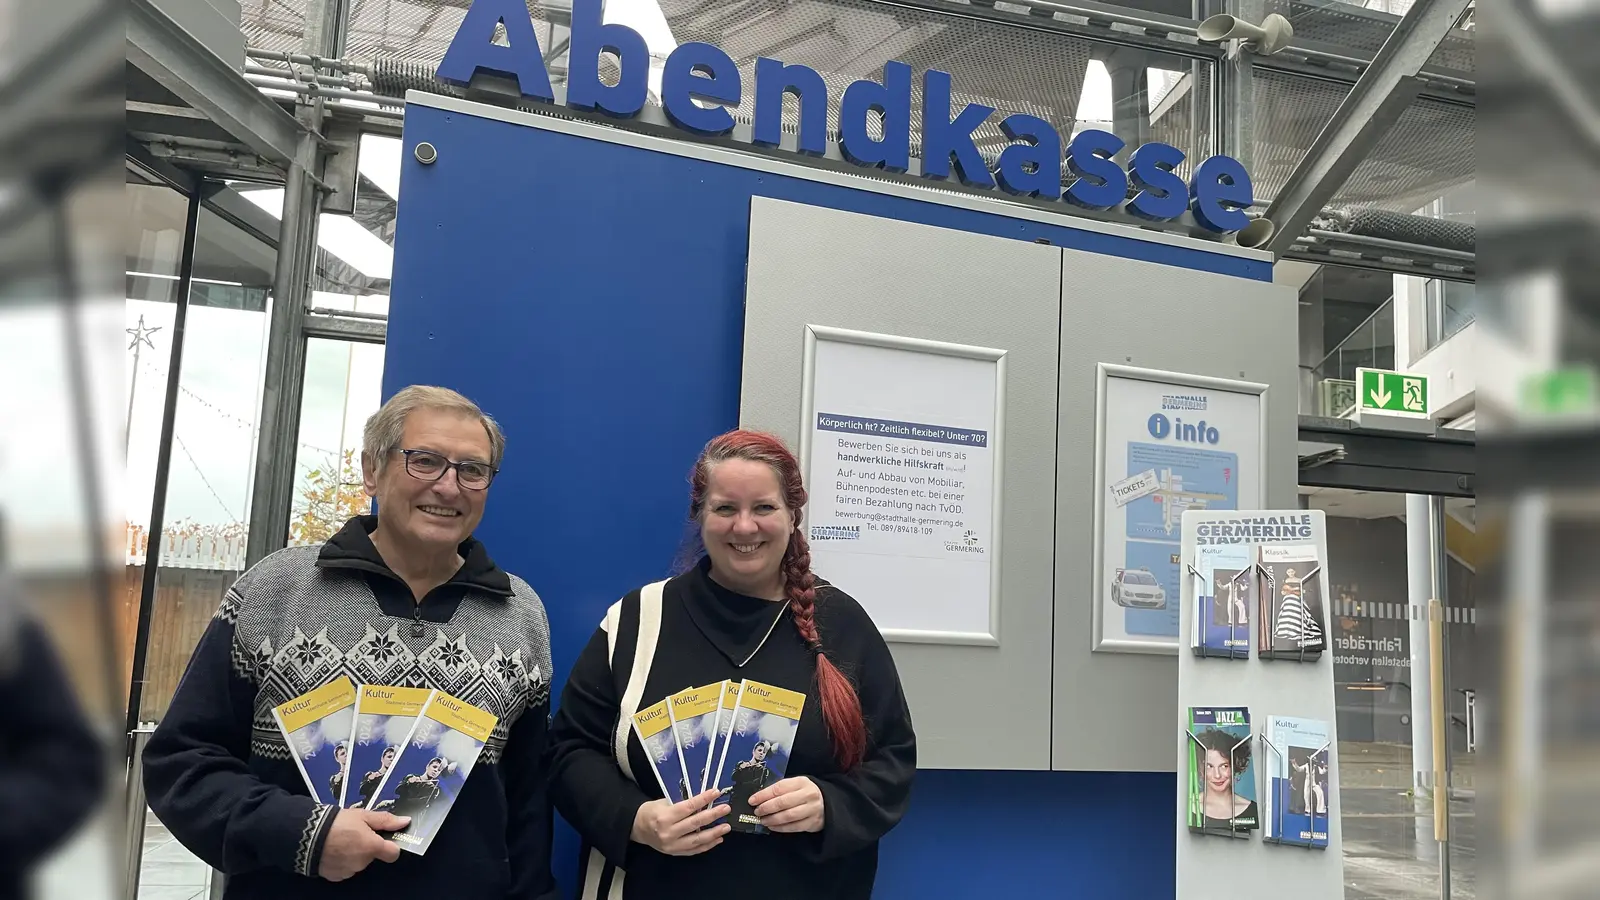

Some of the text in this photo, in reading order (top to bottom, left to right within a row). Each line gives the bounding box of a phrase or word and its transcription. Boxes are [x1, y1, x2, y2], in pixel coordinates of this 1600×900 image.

[436, 0, 1253, 233] Abendkasse
[819, 417, 986, 442] Körperlich fit? Zeitlich flexibel? Unter 70?
[1176, 418, 1219, 444] info
[838, 438, 882, 451] Bewerben
[885, 444, 898, 453] Sie
[901, 446, 918, 455] sich
[921, 448, 934, 456] bei
[954, 452, 966, 460] als
[838, 452, 902, 466] handwerkliche
[904, 458, 944, 470] Hilfskraft
[837, 468, 856, 478] Auf-
[858, 472, 876, 480] und
[878, 472, 906, 482] Abbau
[928, 476, 964, 489] Mobiliar,
[836, 481, 964, 501] Bühnenpodesten etc. bei einer
[1116, 480, 1146, 496] TICKETS
[836, 495, 862, 505] fairen
[866, 497, 912, 512] Bezahlung
[916, 503, 936, 511] nach
[835, 510, 964, 528] bewerbung@stadthalle-germering.de
[1198, 514, 1311, 525] THALLE
[812, 529, 860, 538] GERMERING
[867, 522, 932, 535] Tel. 089/89418-109
[1196, 524, 1312, 538] GERMERING
[946, 544, 984, 554] GERMERING
[366, 689, 394, 699] Kultur
[746, 685, 772, 698] Kultur
[282, 698, 312, 716] Kultur
[436, 696, 462, 712] Kultur
[674, 694, 699, 706] Kultur
[638, 708, 662, 724] Kultur
[1216, 711, 1236, 722] JAZZ
[736, 712, 748, 738] 2024
[1275, 720, 1299, 729] Kultur
[412, 723, 432, 750] 2024
[682, 724, 694, 750] 2024
